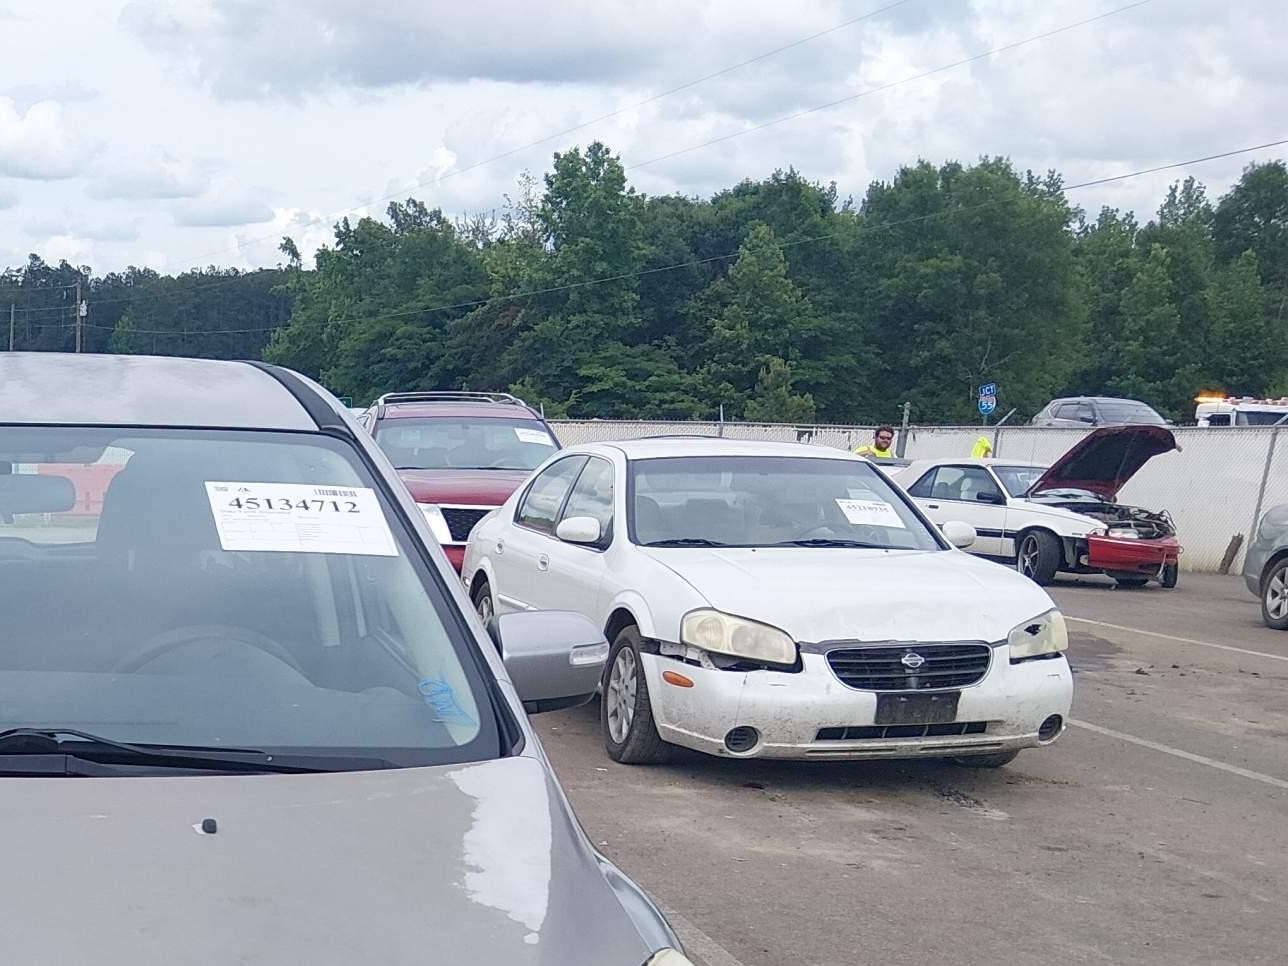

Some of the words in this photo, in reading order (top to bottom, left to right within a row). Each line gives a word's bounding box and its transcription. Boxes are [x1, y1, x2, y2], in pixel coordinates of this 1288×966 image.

[981, 385, 994, 396] JCT
[981, 401, 993, 410] 55
[228, 497, 361, 514] 45134712
